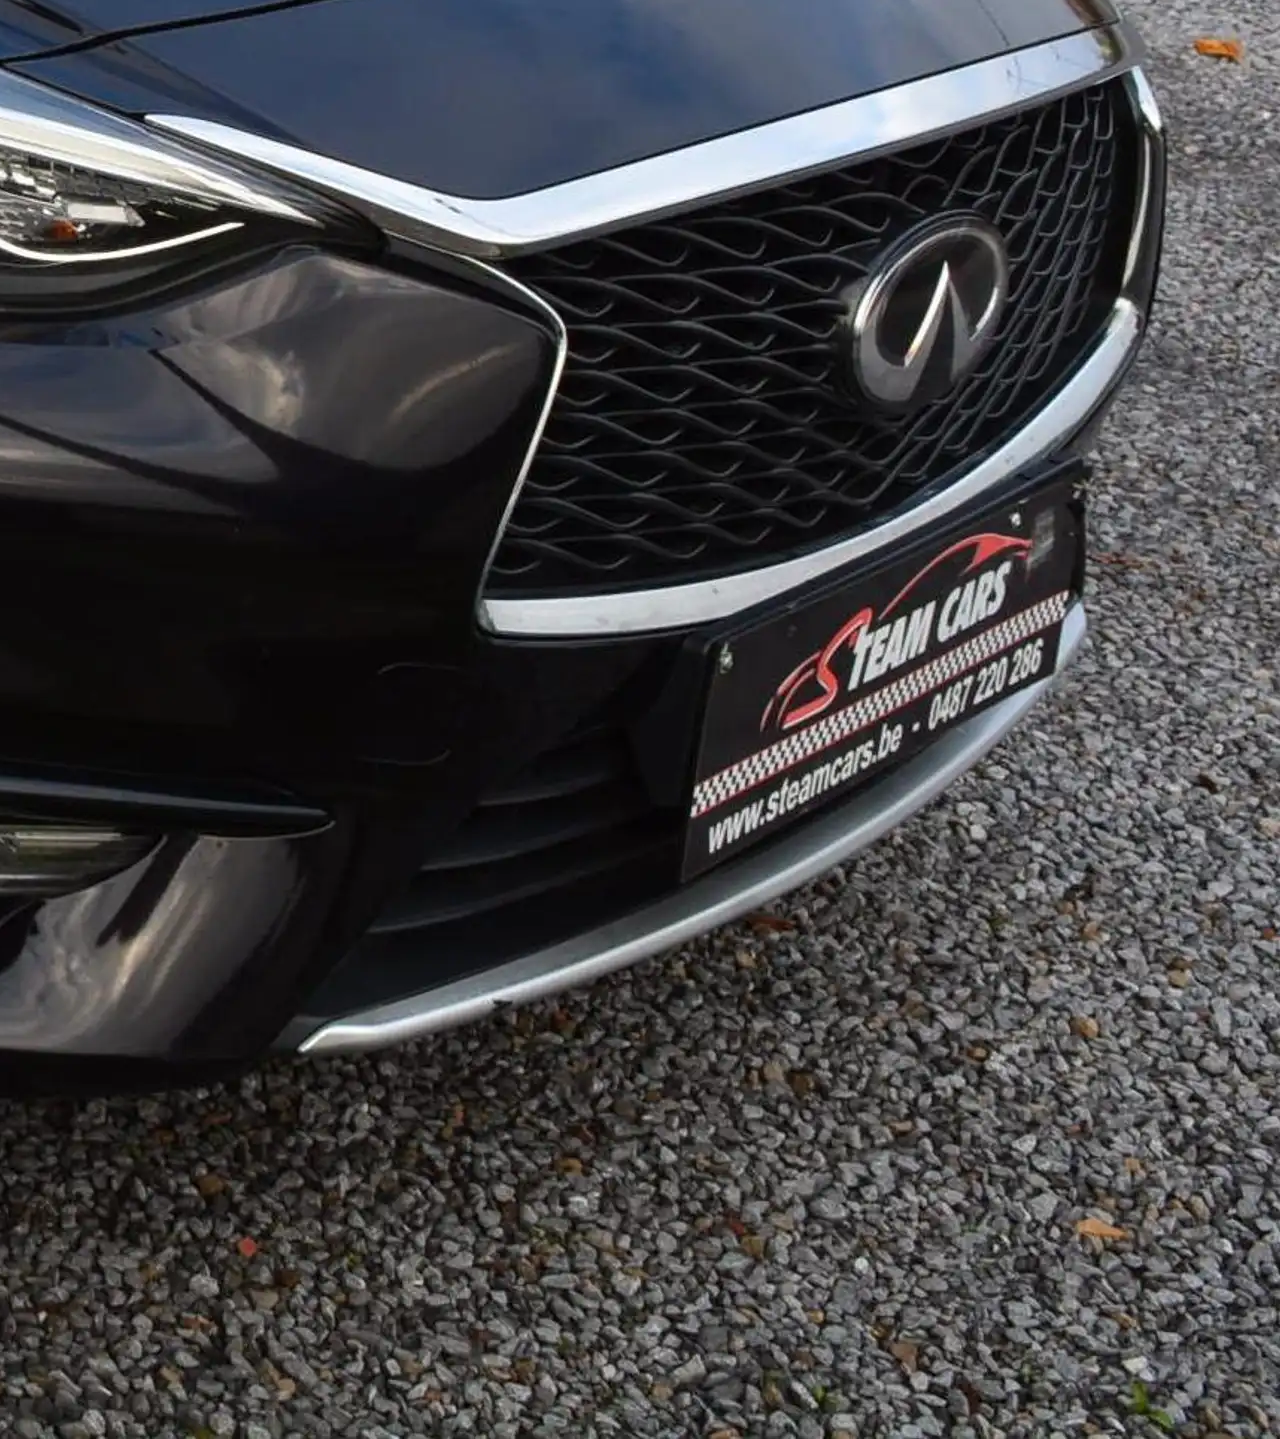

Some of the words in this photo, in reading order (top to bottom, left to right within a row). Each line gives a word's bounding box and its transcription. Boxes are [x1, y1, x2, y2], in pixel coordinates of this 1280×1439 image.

[936, 560, 1011, 643] CARS
[707, 721, 903, 855] www.steamcars.be
[927, 686, 972, 731] 0487
[973, 657, 1009, 704] 220
[1010, 638, 1043, 685] 286
